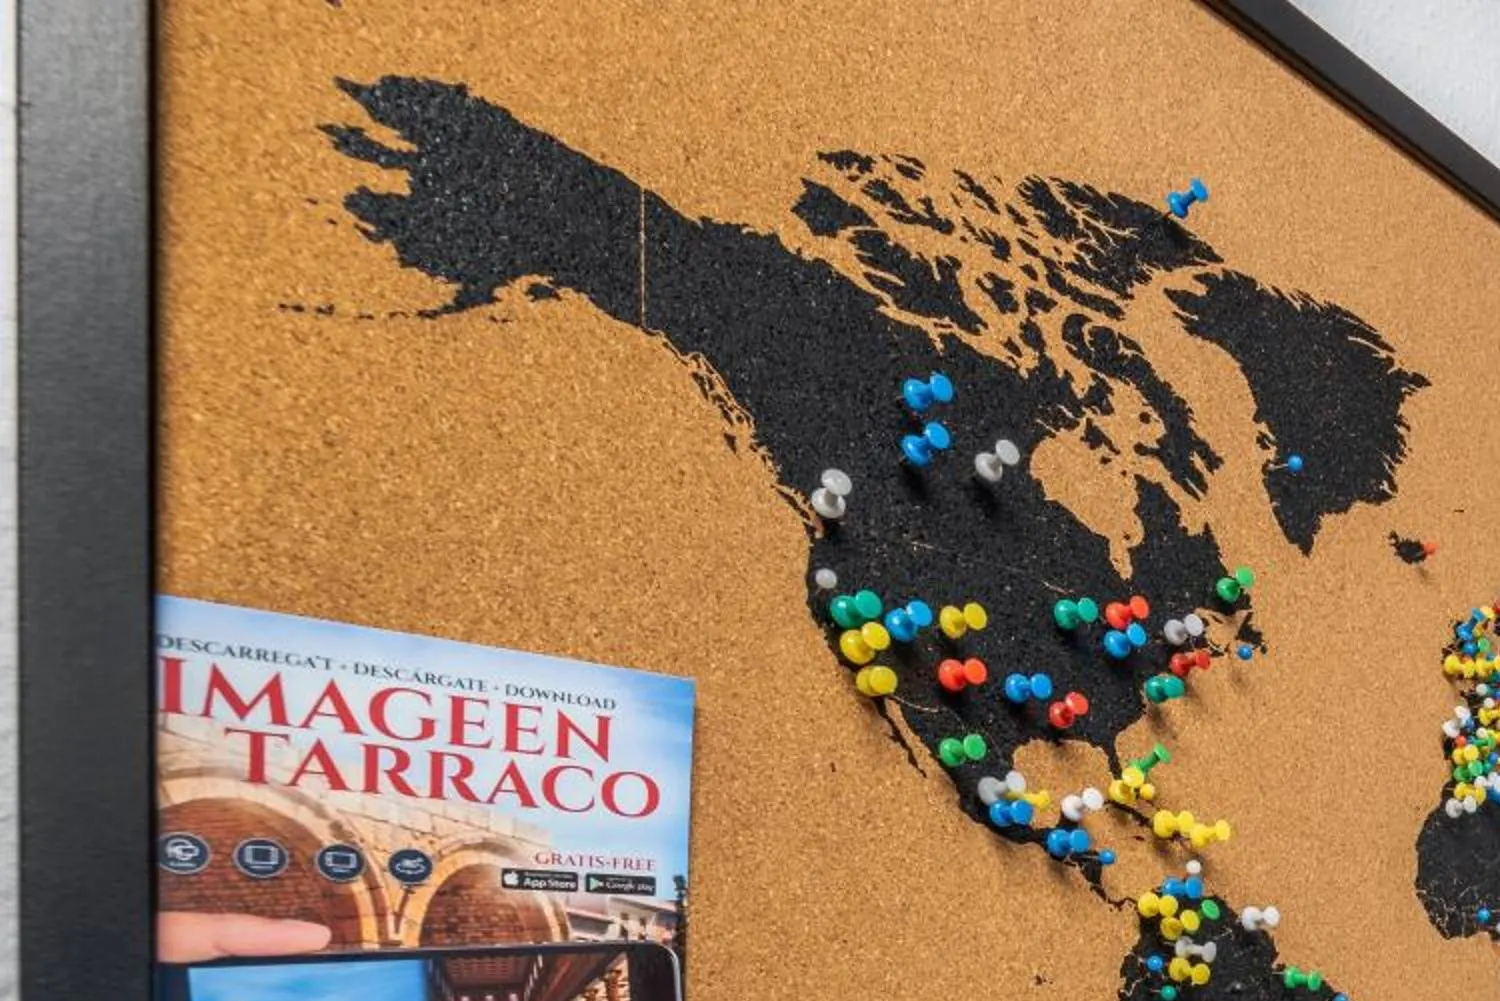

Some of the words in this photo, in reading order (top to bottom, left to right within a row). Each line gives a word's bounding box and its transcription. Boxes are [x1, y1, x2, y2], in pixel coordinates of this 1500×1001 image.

[159, 655, 612, 764] IMAGEEN
[353, 663, 488, 693] DESCÁRGATE
[504, 682, 617, 712] DOWNLOAD
[223, 727, 661, 819] TARRACO
[523, 877, 547, 889] App
[549, 878, 577, 889] Store
